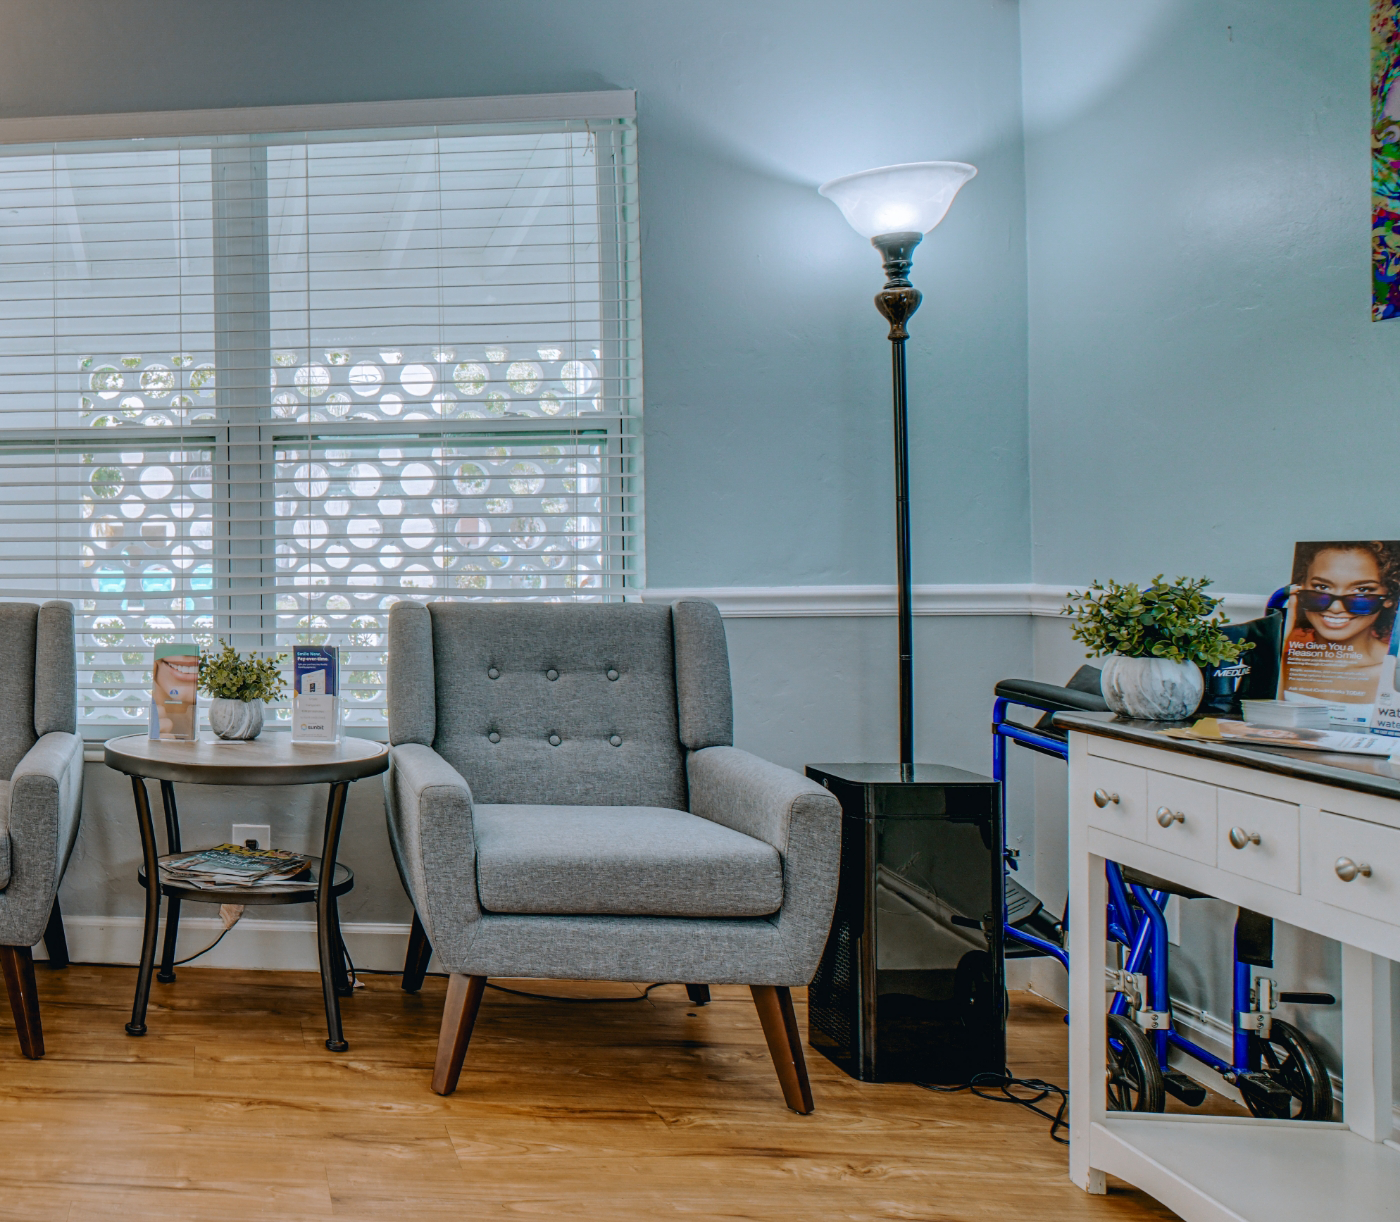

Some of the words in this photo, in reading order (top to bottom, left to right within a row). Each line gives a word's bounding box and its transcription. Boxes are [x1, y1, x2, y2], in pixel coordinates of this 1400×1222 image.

[1289, 641, 1304, 649] We
[1305, 642, 1327, 650] Give
[1328, 643, 1346, 651] You
[1288, 649, 1323, 657] Reason
[1336, 651, 1363, 660] Smile
